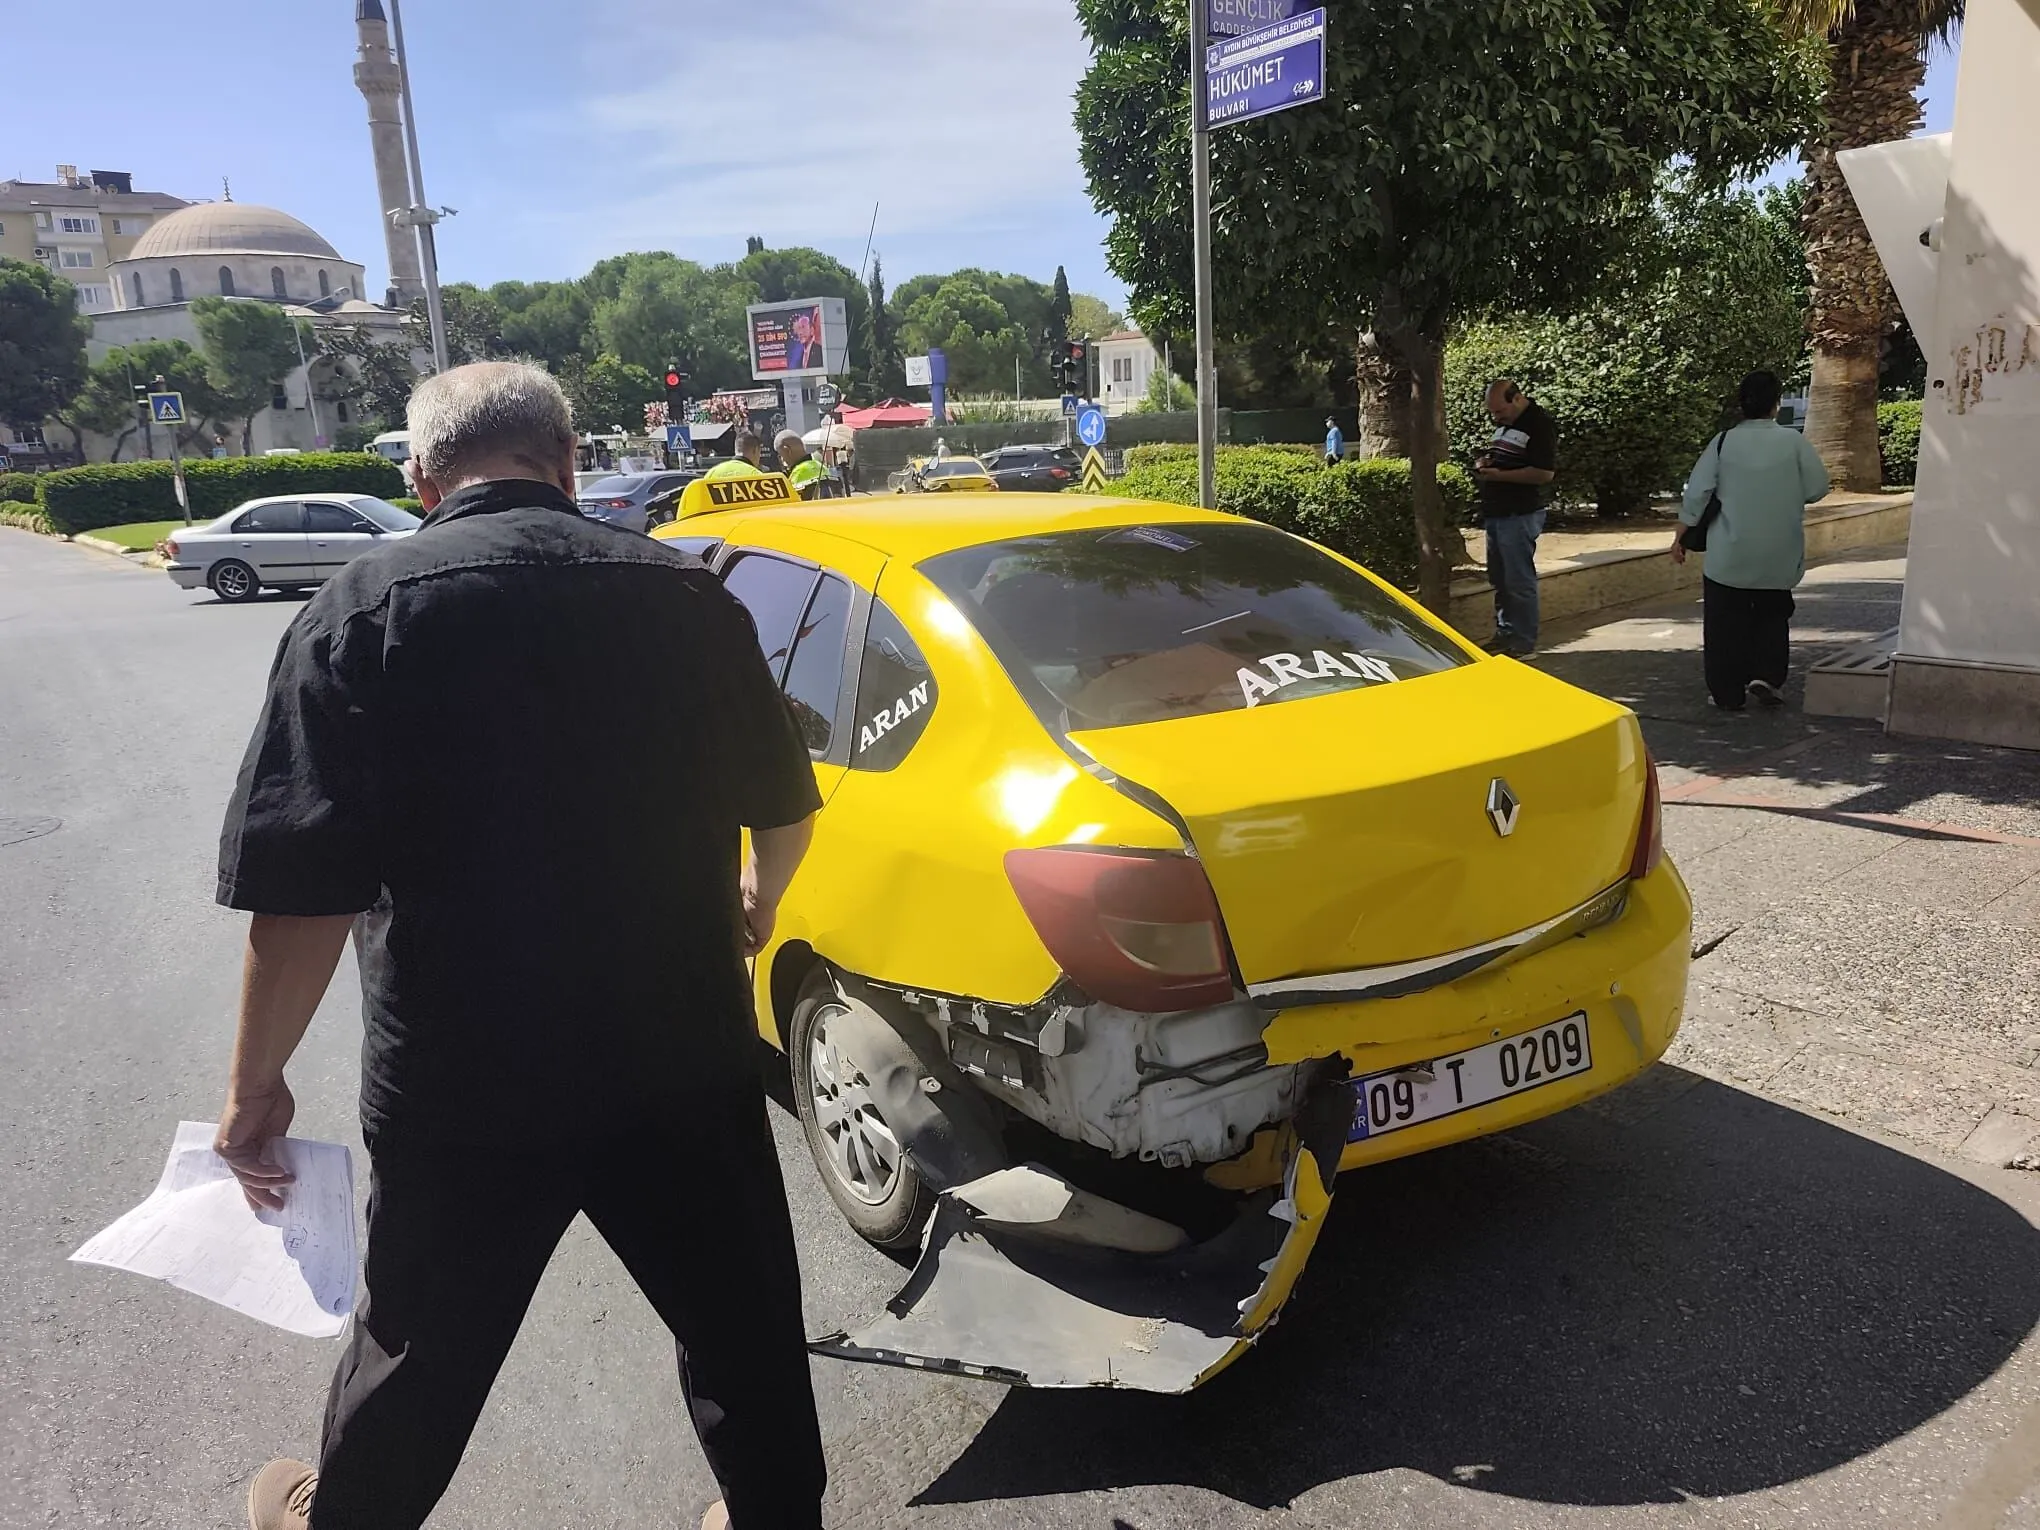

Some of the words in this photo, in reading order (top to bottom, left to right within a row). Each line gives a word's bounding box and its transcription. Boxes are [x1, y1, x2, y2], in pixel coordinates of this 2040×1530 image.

[1223, 42, 1241, 54] AYDIN
[1210, 56, 1285, 101] HÜKÜMET
[1209, 98, 1249, 121] BULVARI
[1236, 650, 1400, 708] ARAN
[859, 680, 928, 753] ARAN
[1370, 1079, 1415, 1128] 09
[1446, 1059, 1466, 1104] T
[1499, 1023, 1582, 1088] 0209
